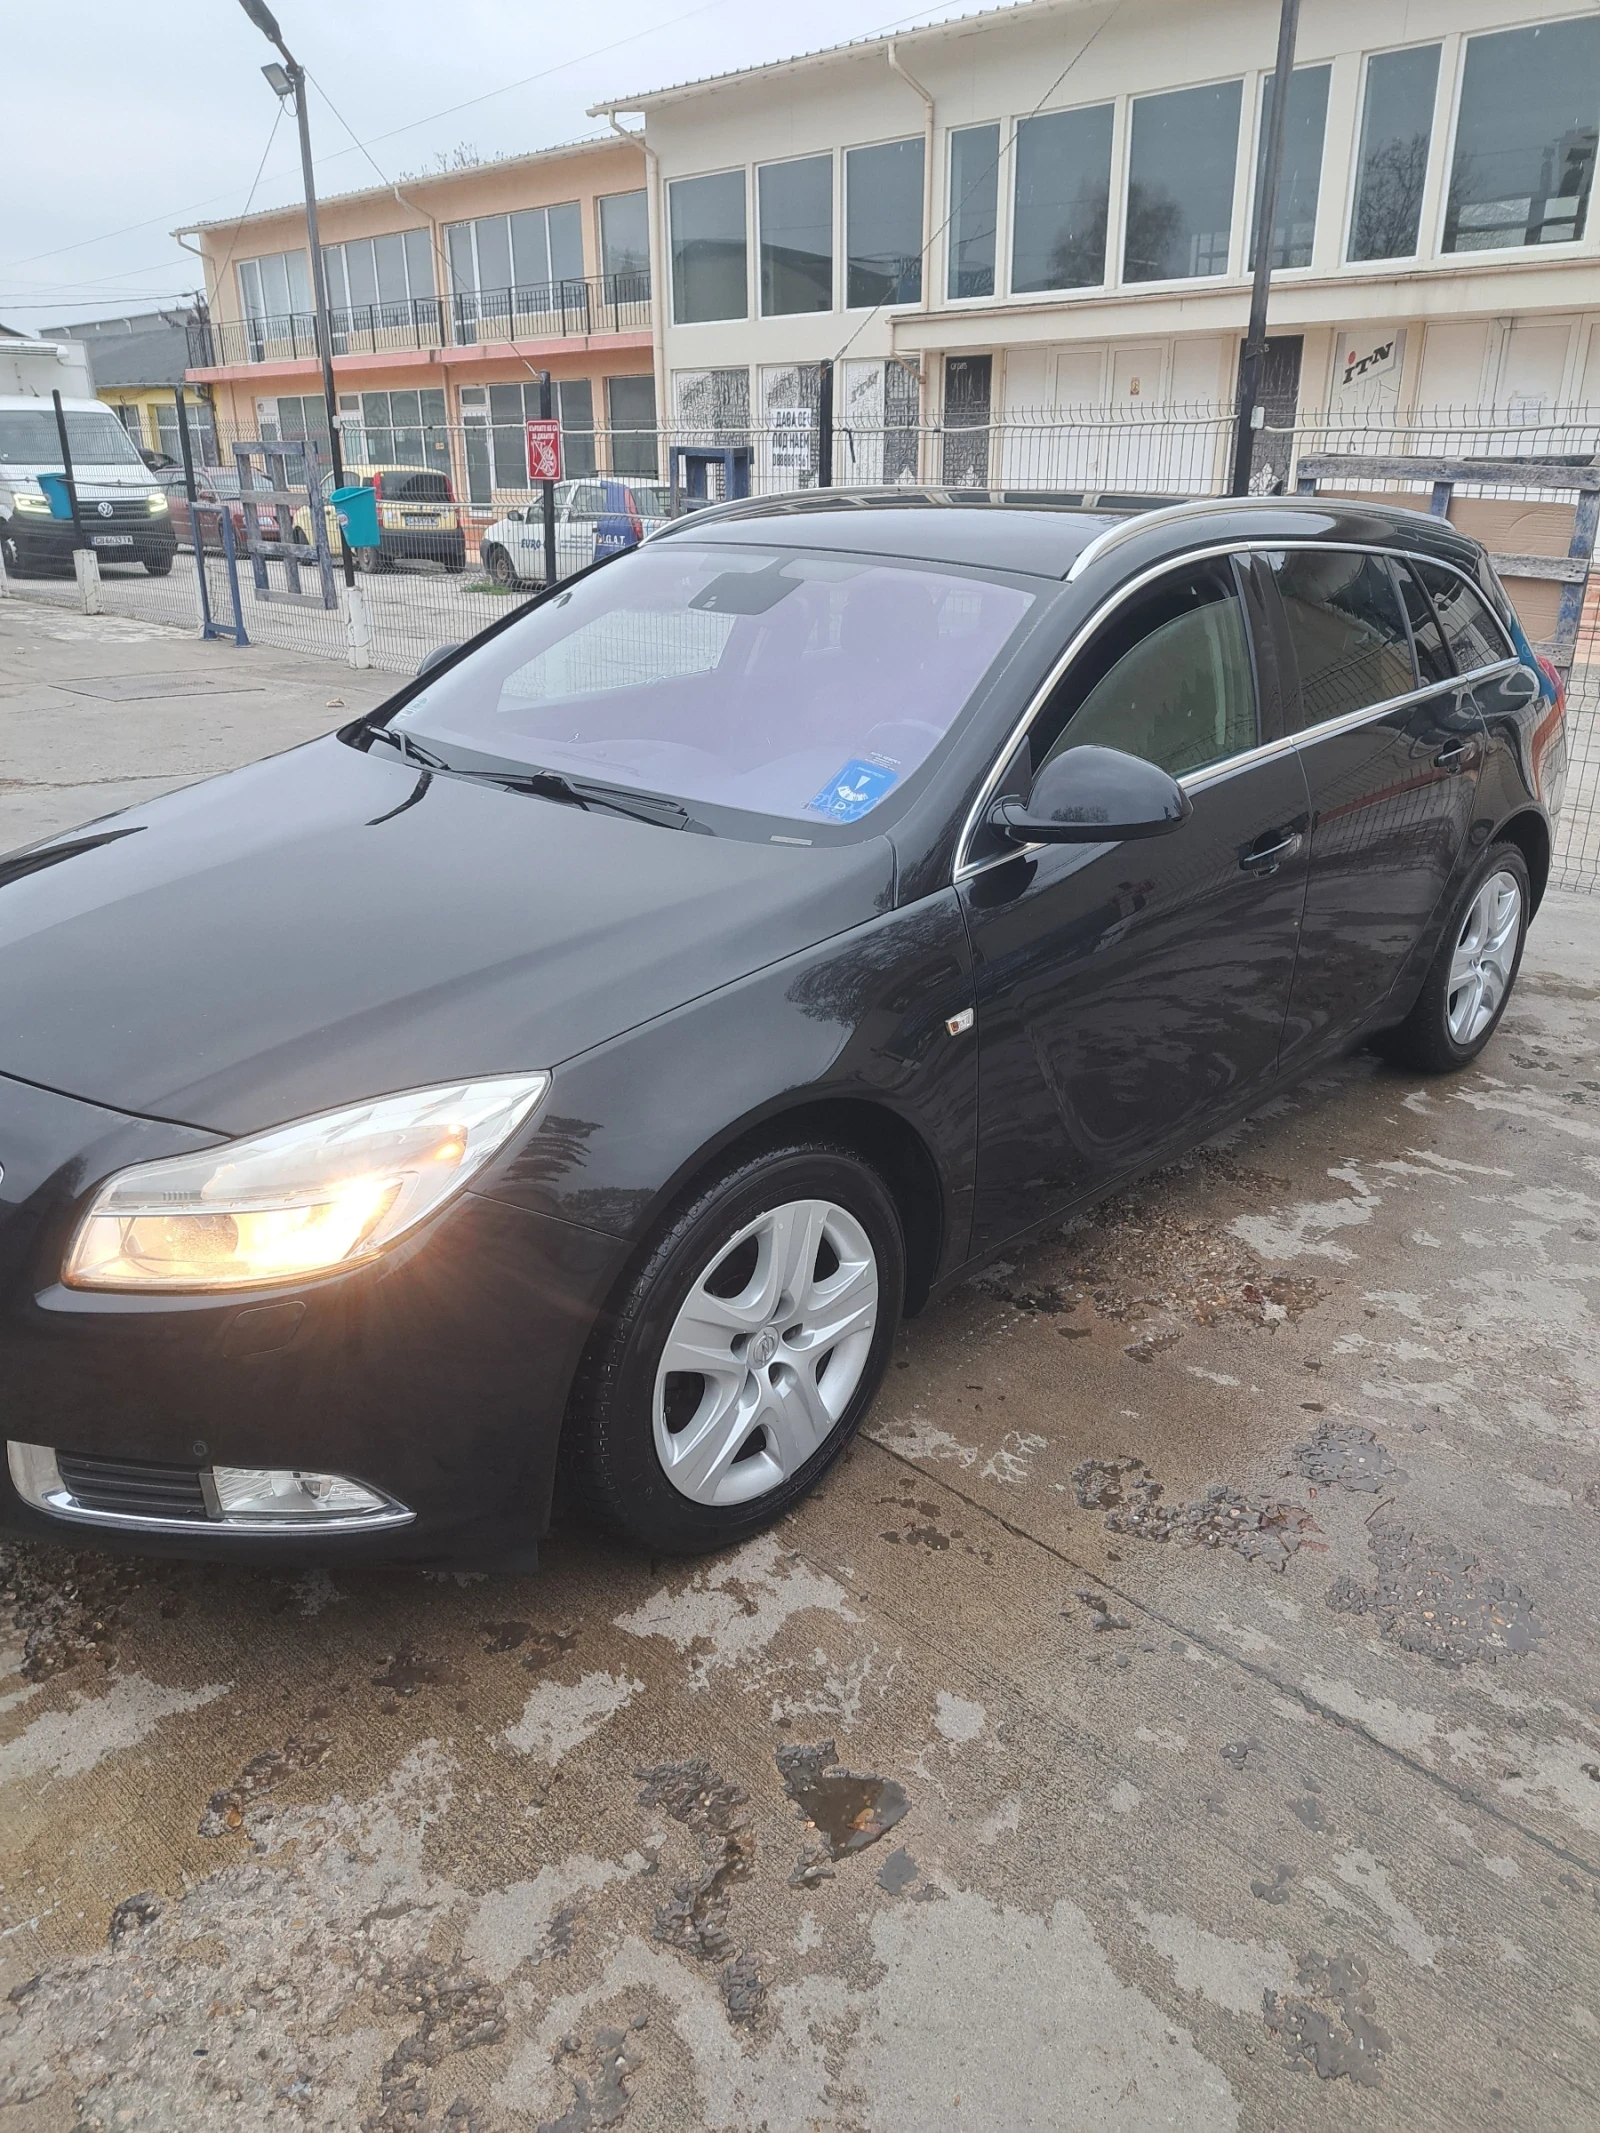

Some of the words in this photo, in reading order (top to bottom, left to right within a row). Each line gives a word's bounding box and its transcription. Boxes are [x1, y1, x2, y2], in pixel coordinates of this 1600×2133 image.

[776, 411, 797, 428] ДАВА
[798, 411, 807, 428] СЕ
[772, 432, 788, 451] ПОД
[789, 432, 810, 449] НАЕМ
